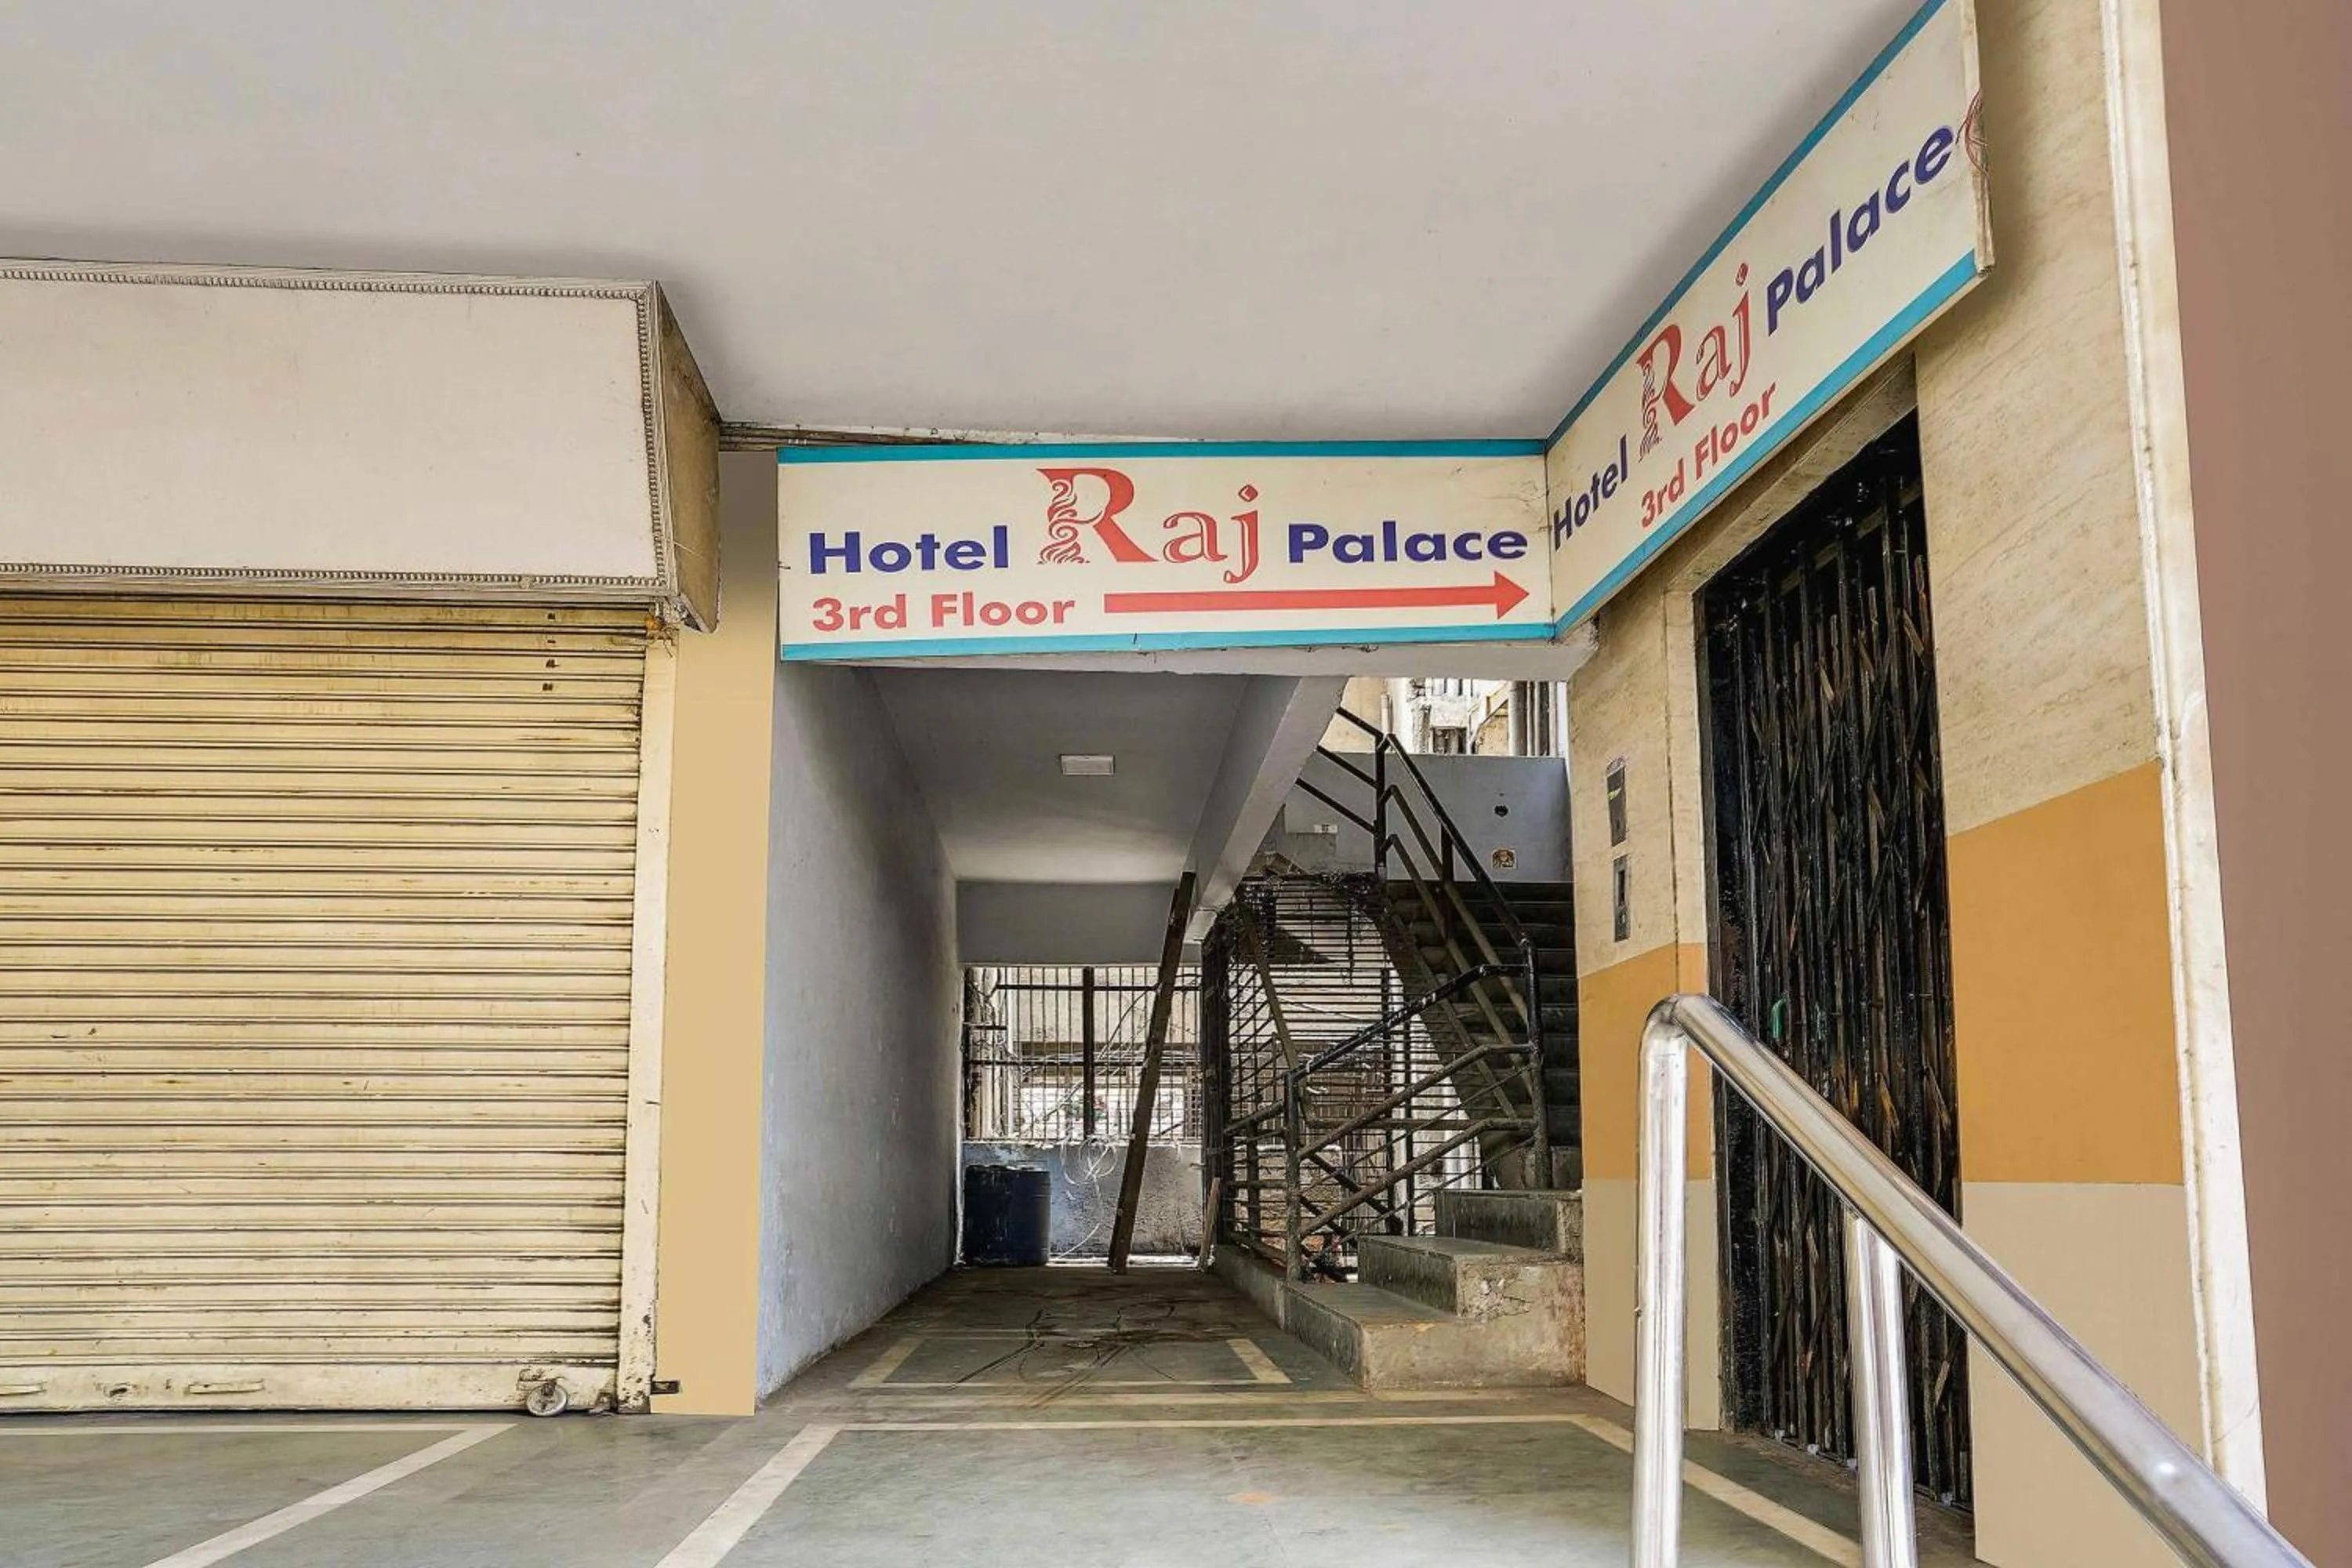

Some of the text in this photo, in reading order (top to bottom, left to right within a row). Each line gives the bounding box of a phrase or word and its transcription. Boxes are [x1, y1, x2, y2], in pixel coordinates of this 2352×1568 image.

[1553, 125, 1954, 550] Hotel Raj Palace
[1641, 382, 1776, 529] 3rd Floor
[809, 466, 1528, 583] Hotel Raj Palace
[812, 592, 1076, 632] 3rd Floor
